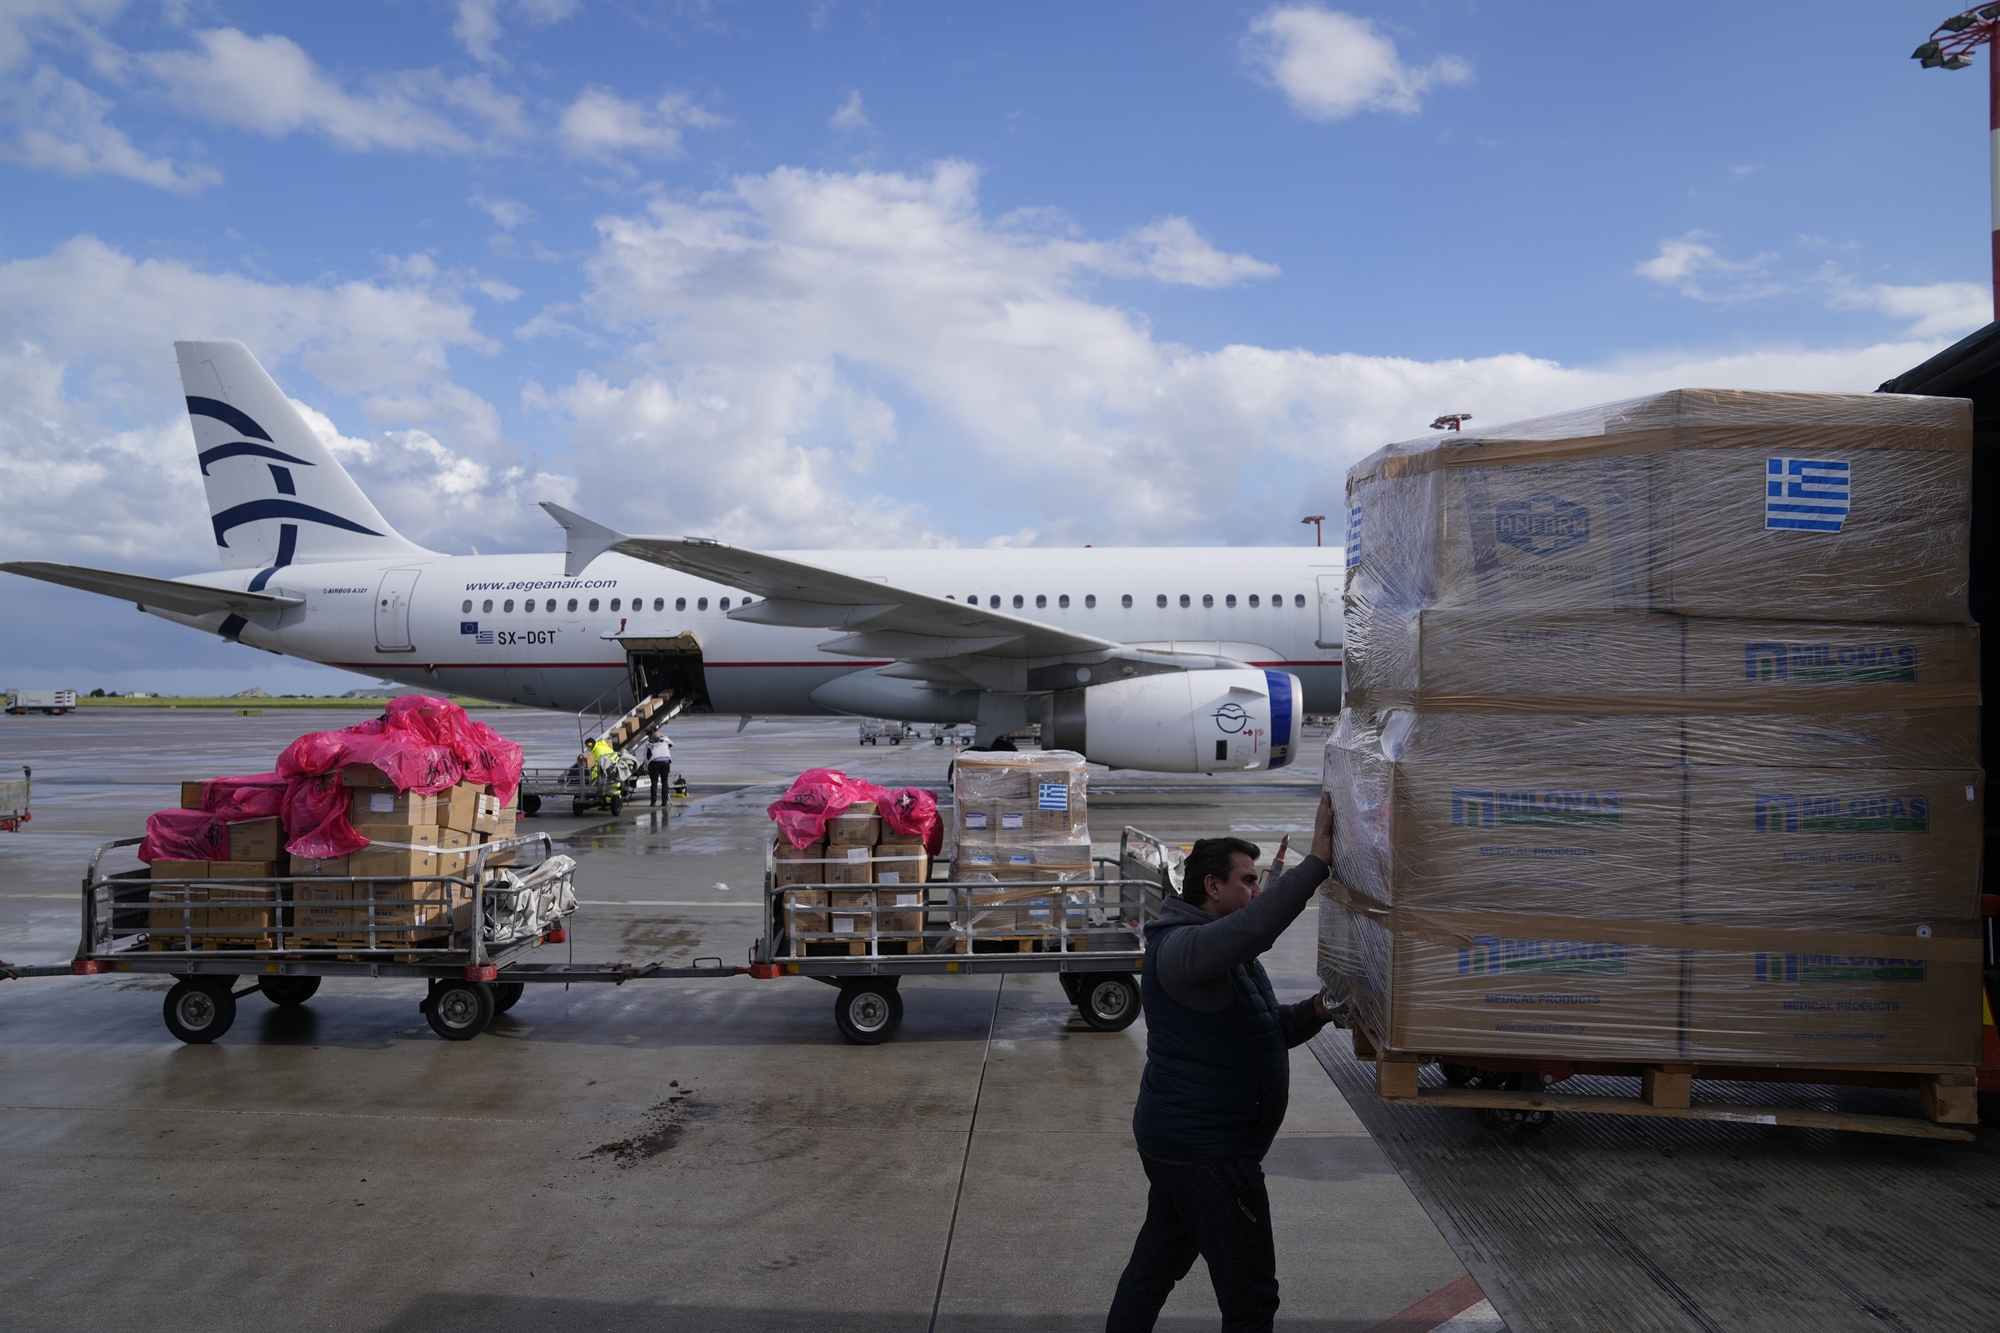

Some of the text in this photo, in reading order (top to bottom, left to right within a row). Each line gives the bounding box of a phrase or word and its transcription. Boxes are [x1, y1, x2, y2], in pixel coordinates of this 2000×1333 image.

[1500, 515, 1586, 535] ANFARM
[466, 579, 618, 592] www.aegeanair.com
[498, 631, 556, 645] SX-DGT
[1792, 646, 1915, 666] MILONAS
[1501, 792, 1621, 812] MILONAS
[1803, 797, 1926, 818] MILONAS
[1480, 847, 1596, 857] MEDICAL PRODUCTS
[1783, 852, 1902, 863] MEDICAL PRODUCTS
[1504, 939, 1625, 960] MILONAS
[1485, 995, 1601, 1005] MEDICAL PRODUCTS
[1783, 1001, 1900, 1011] MEDICAL PRODUCTS
[1494, 1024, 1586, 1034] www.milonashealth.gr
[1793, 1031, 1885, 1041] www.milonashealth.gr
